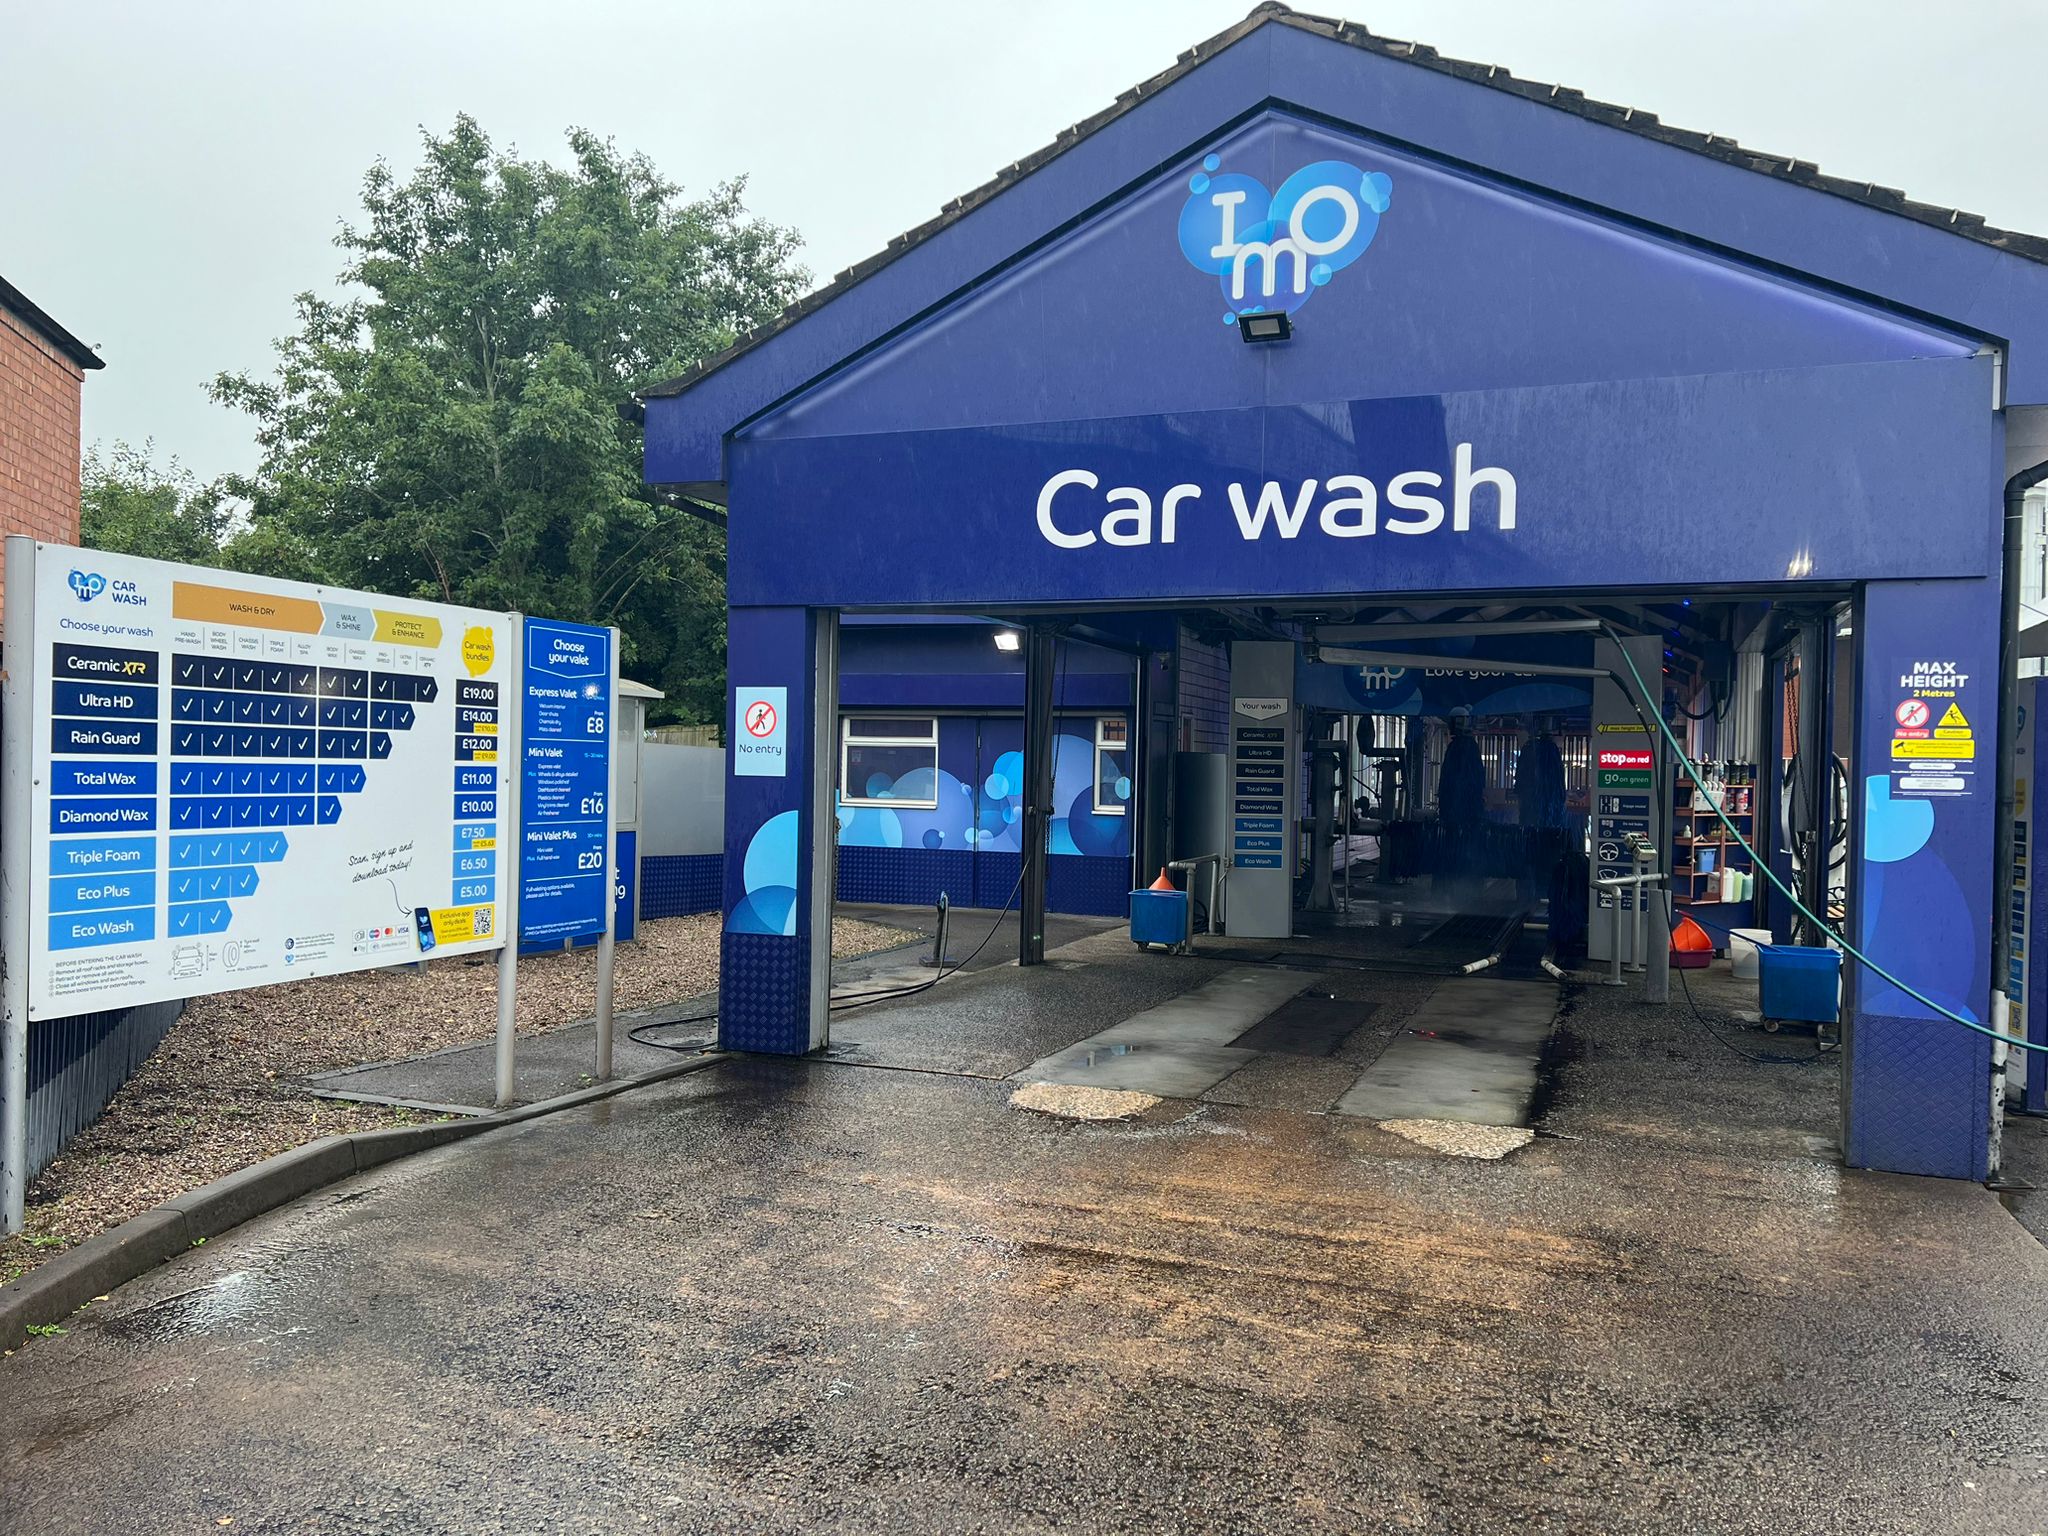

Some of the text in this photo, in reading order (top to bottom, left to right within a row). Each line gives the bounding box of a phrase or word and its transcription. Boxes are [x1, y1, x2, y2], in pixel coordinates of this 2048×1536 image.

[1036, 442, 1517, 548] Car wash
[112, 580, 136, 592] CAR
[112, 592, 147, 606] WASH
[229, 603, 276, 616] WASH & DRY
[341, 613, 357, 622] WAX
[60, 618, 153, 637] Choose your wash
[342, 622, 361, 631] SHINE
[395, 620, 423, 631] PROTECT
[397, 630, 425, 639] ENHANCE
[464, 641, 492, 652] Car wash
[553, 639, 585, 653] Choose
[466, 652, 490, 662] bundles
[548, 652, 590, 666] your valet
[67, 656, 147, 676] Ceramic XTR
[1913, 661, 1956, 675] MAX
[1900, 674, 1969, 688] HEIGHT
[463, 687, 494, 700] £19.00
[529, 686, 559, 699] Express
[559, 688, 577, 699] Valet
[1913, 689, 1956, 698] 2 Metres
[79, 693, 134, 708] Ultra HD
[1260, 702, 1282, 711] wash
[462, 710, 493, 723] £14.00
[586, 716, 604, 733] £8
[71, 731, 141, 745] Rain Guard
[462, 738, 492, 750] £12.00
[528, 747, 563, 758] Mini Valet
[739, 744, 782, 756] No entry
[1600, 752, 1626, 766] stop
[1637, 755, 1650, 763] red
[73, 771, 137, 785] Total Wax
[462, 773, 492, 785] £11.00
[1604, 773, 1619, 784] go
[1629, 776, 1649, 784] green
[461, 801, 494, 813] £10.00
[581, 797, 604, 815] £16
[60, 809, 149, 823] Diamond Wax
[461, 827, 485, 839] £7.50
[527, 829, 577, 842] Mini Valet Plus
[66, 850, 140, 866] Triple Foam
[371, 849, 386, 864] sign
[399, 839, 414, 852] and
[460, 858, 487, 870] £6.50
[578, 851, 602, 869] £20
[352, 863, 389, 883] download
[77, 885, 131, 900] Eco Plus
[460, 885, 487, 898] £5.00
[71, 919, 134, 938] Eco Wash
[397, 926, 409, 934] VISA
[56, 960, 77, 968] BEFORE
[78, 957, 104, 965] ENTERING
